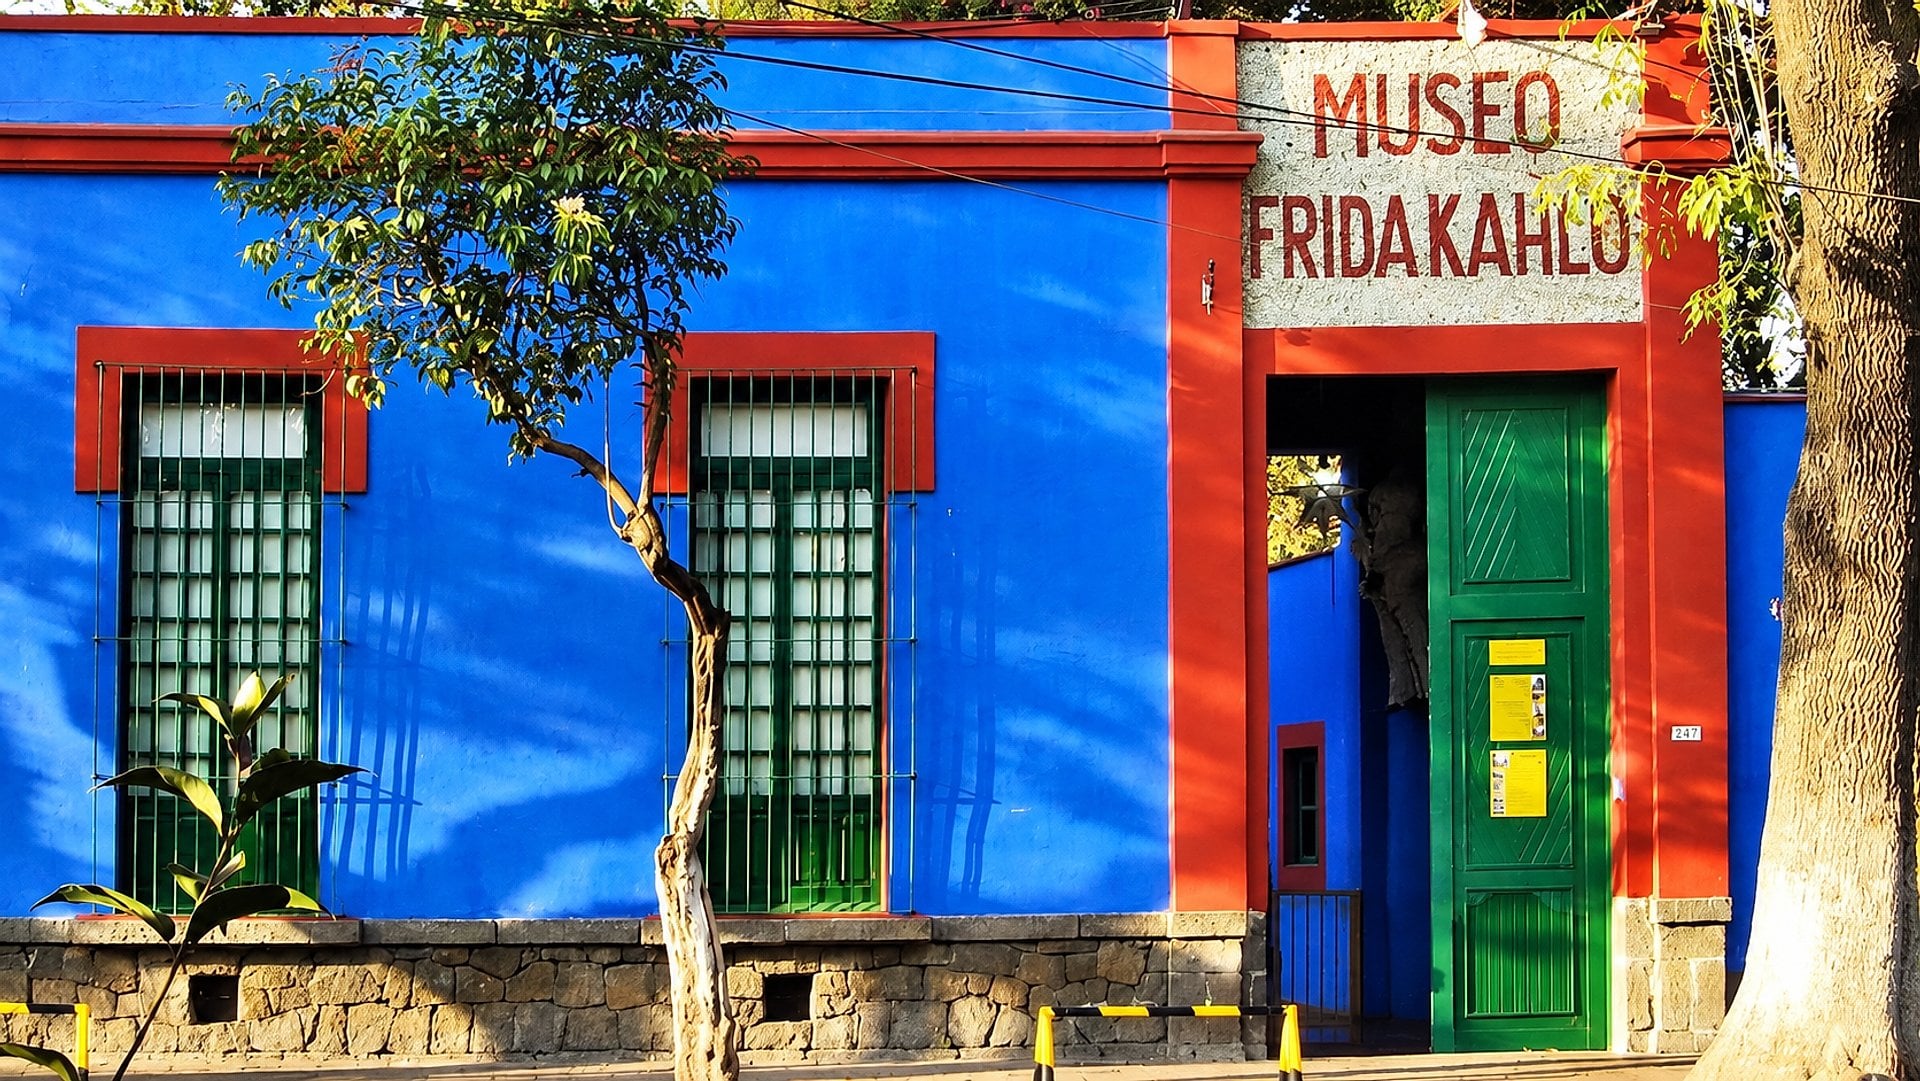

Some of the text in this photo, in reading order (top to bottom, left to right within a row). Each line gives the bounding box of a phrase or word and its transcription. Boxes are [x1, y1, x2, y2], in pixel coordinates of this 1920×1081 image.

[1313, 71, 1561, 159] MUSEO
[1249, 192, 1630, 279] FRIDA KAHLO
[1675, 727, 1698, 739] 247
